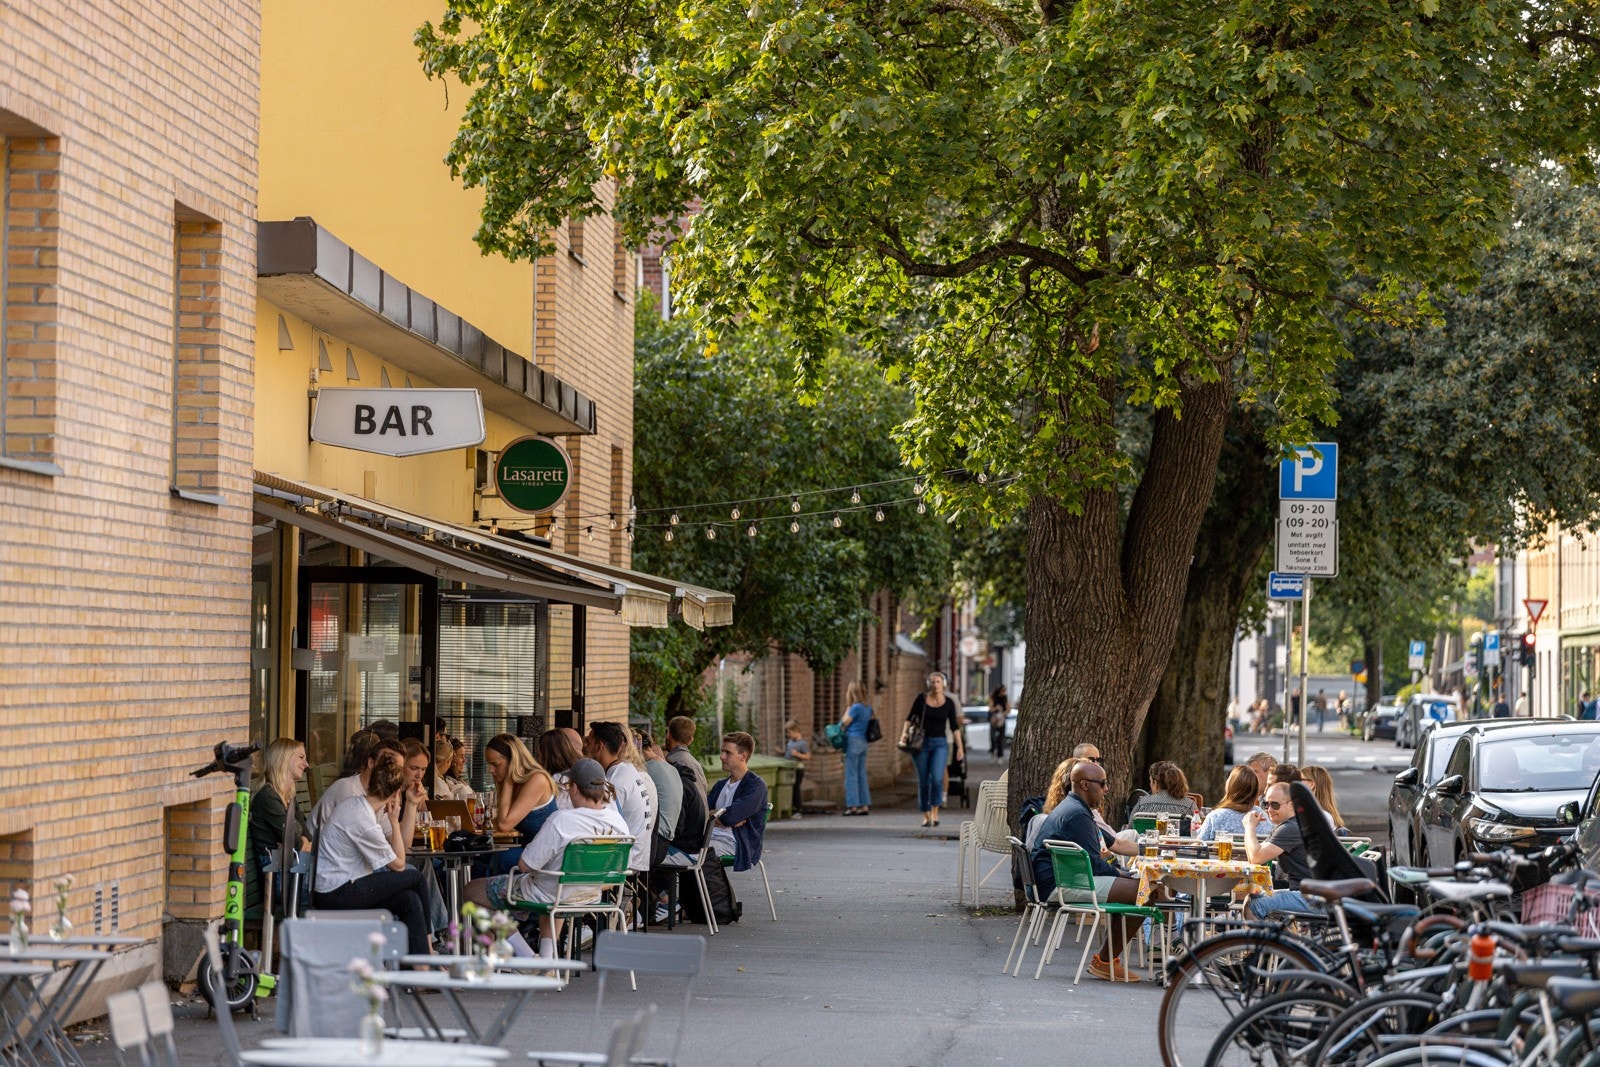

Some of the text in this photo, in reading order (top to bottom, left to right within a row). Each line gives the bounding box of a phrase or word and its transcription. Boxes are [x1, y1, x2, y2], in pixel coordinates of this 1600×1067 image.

[354, 404, 434, 436] BAR
[503, 467, 564, 481] Lasarett
[1294, 450, 1323, 492] P
